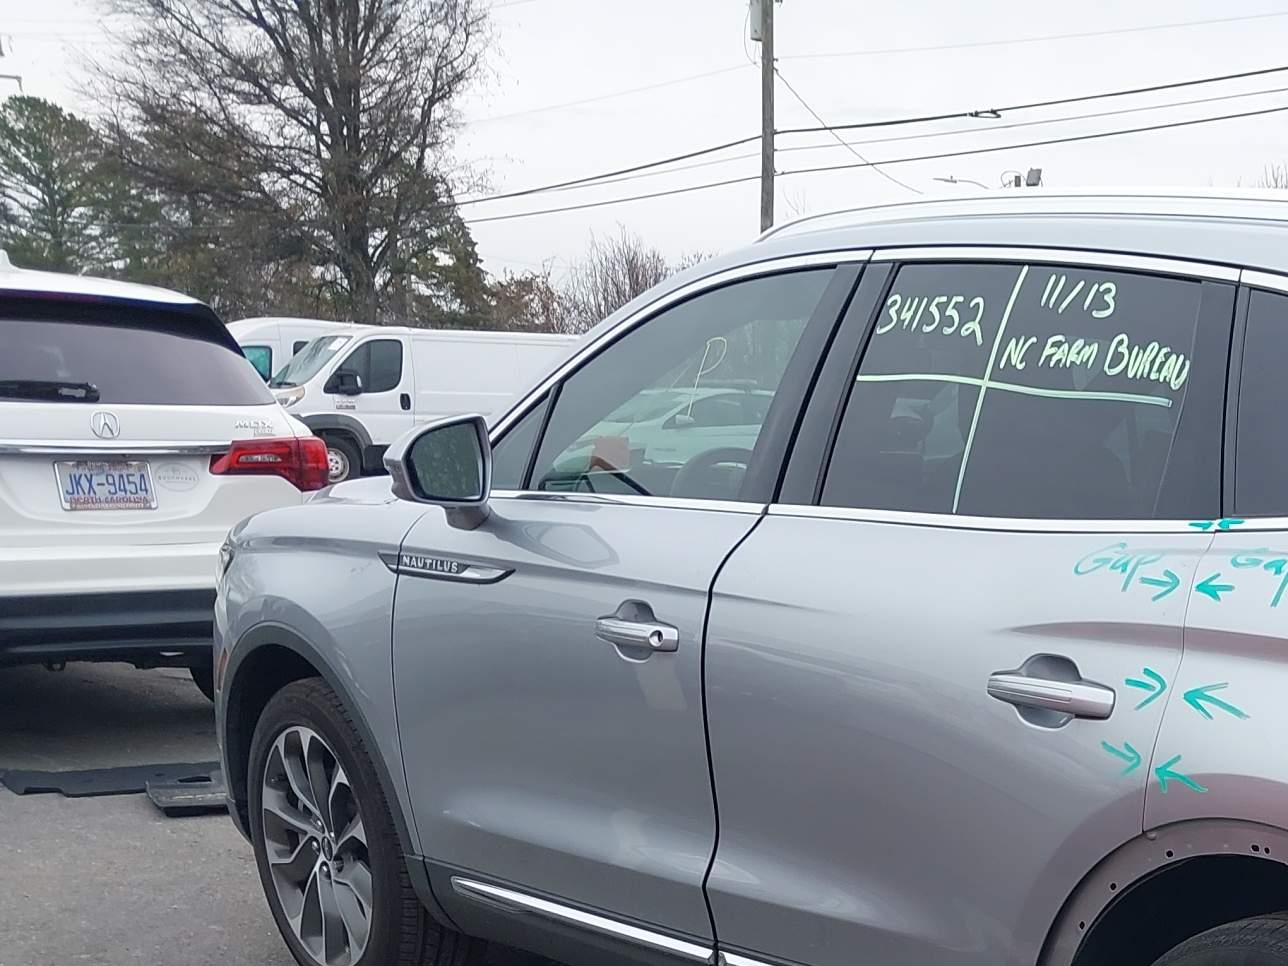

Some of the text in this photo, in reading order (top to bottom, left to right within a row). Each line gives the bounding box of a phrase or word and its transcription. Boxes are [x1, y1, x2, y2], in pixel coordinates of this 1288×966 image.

[1040, 273, 1117, 319] 11/13
[876, 294, 986, 347] 341552
[999, 332, 1190, 391] NC FARM BUREAU
[65, 473, 149, 496] JKX-9454
[402, 555, 459, 573] NAUTILUS
[1073, 542, 1165, 593] Gap
